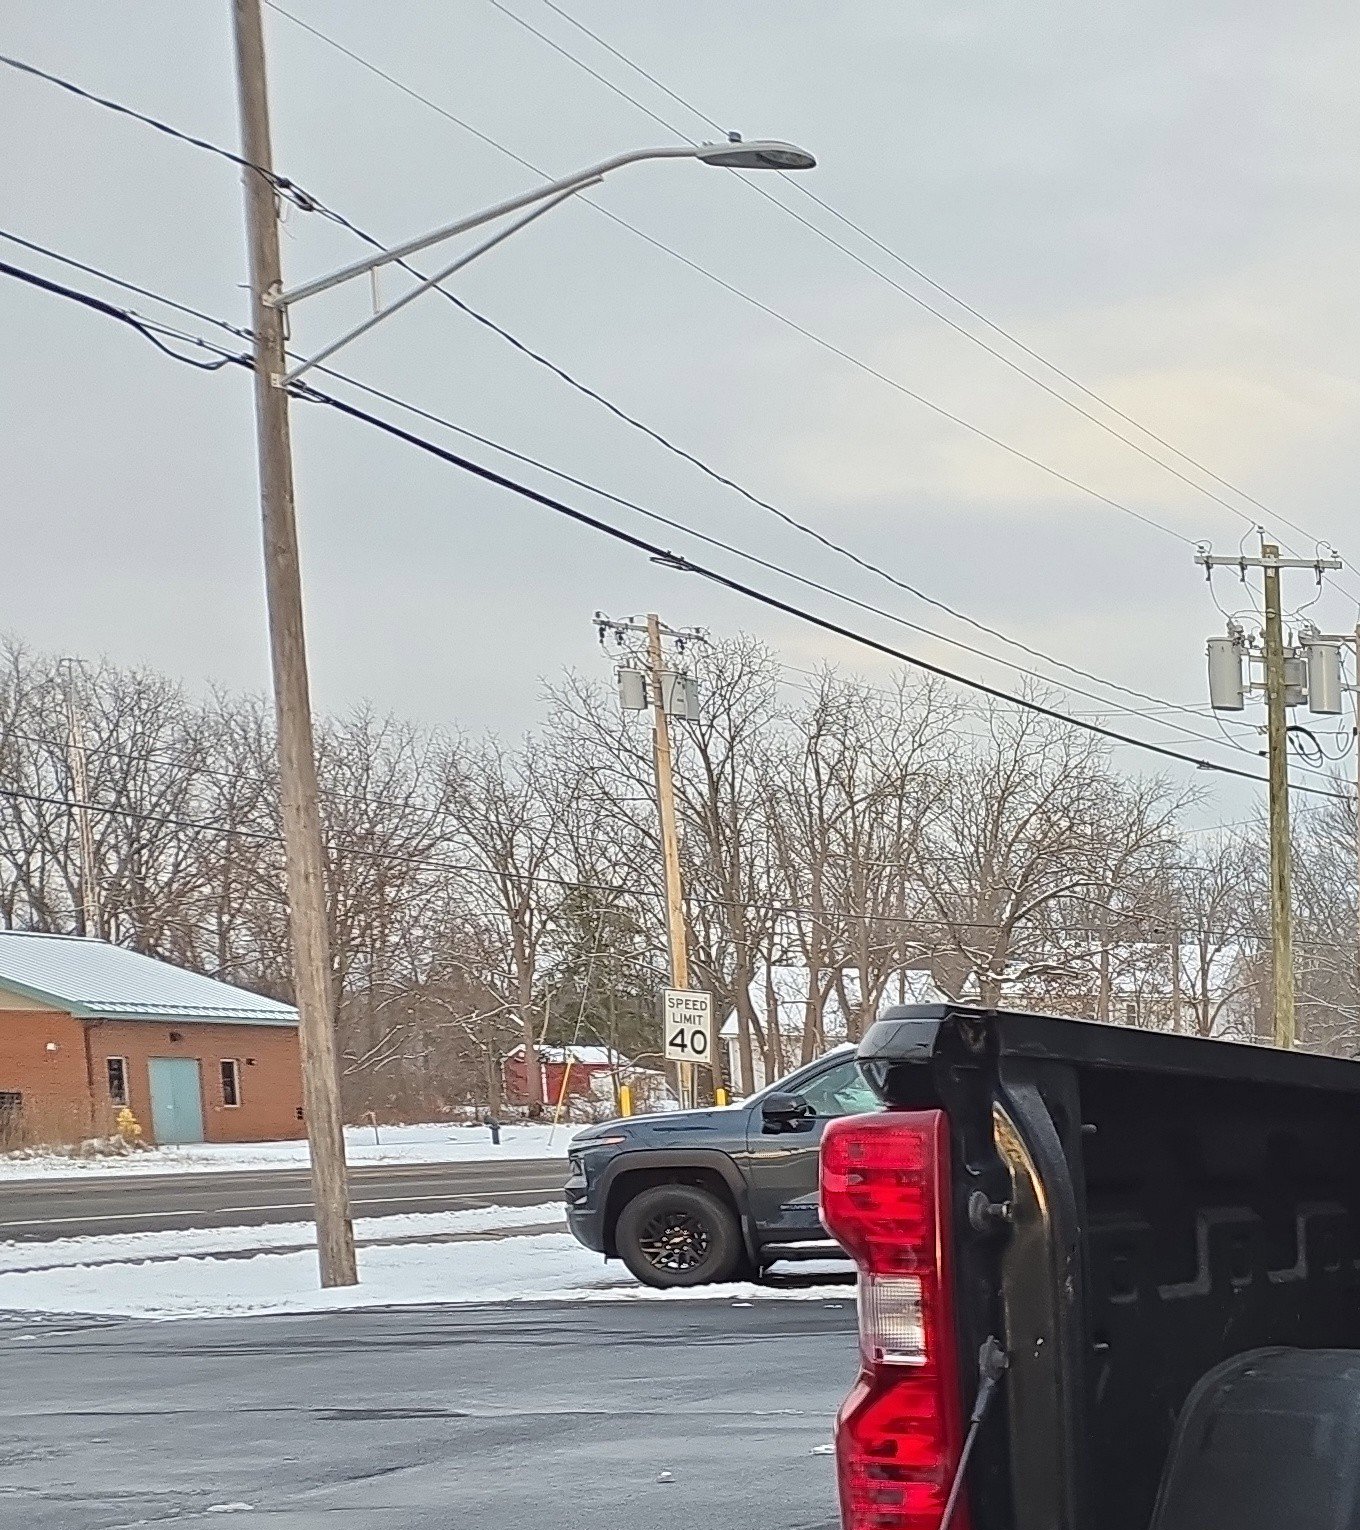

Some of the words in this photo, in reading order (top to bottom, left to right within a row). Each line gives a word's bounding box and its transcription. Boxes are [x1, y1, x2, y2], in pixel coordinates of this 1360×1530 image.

[668, 998, 707, 1010] SPEED
[673, 1013, 703, 1025] LIMIT
[669, 1027, 707, 1055] 40
